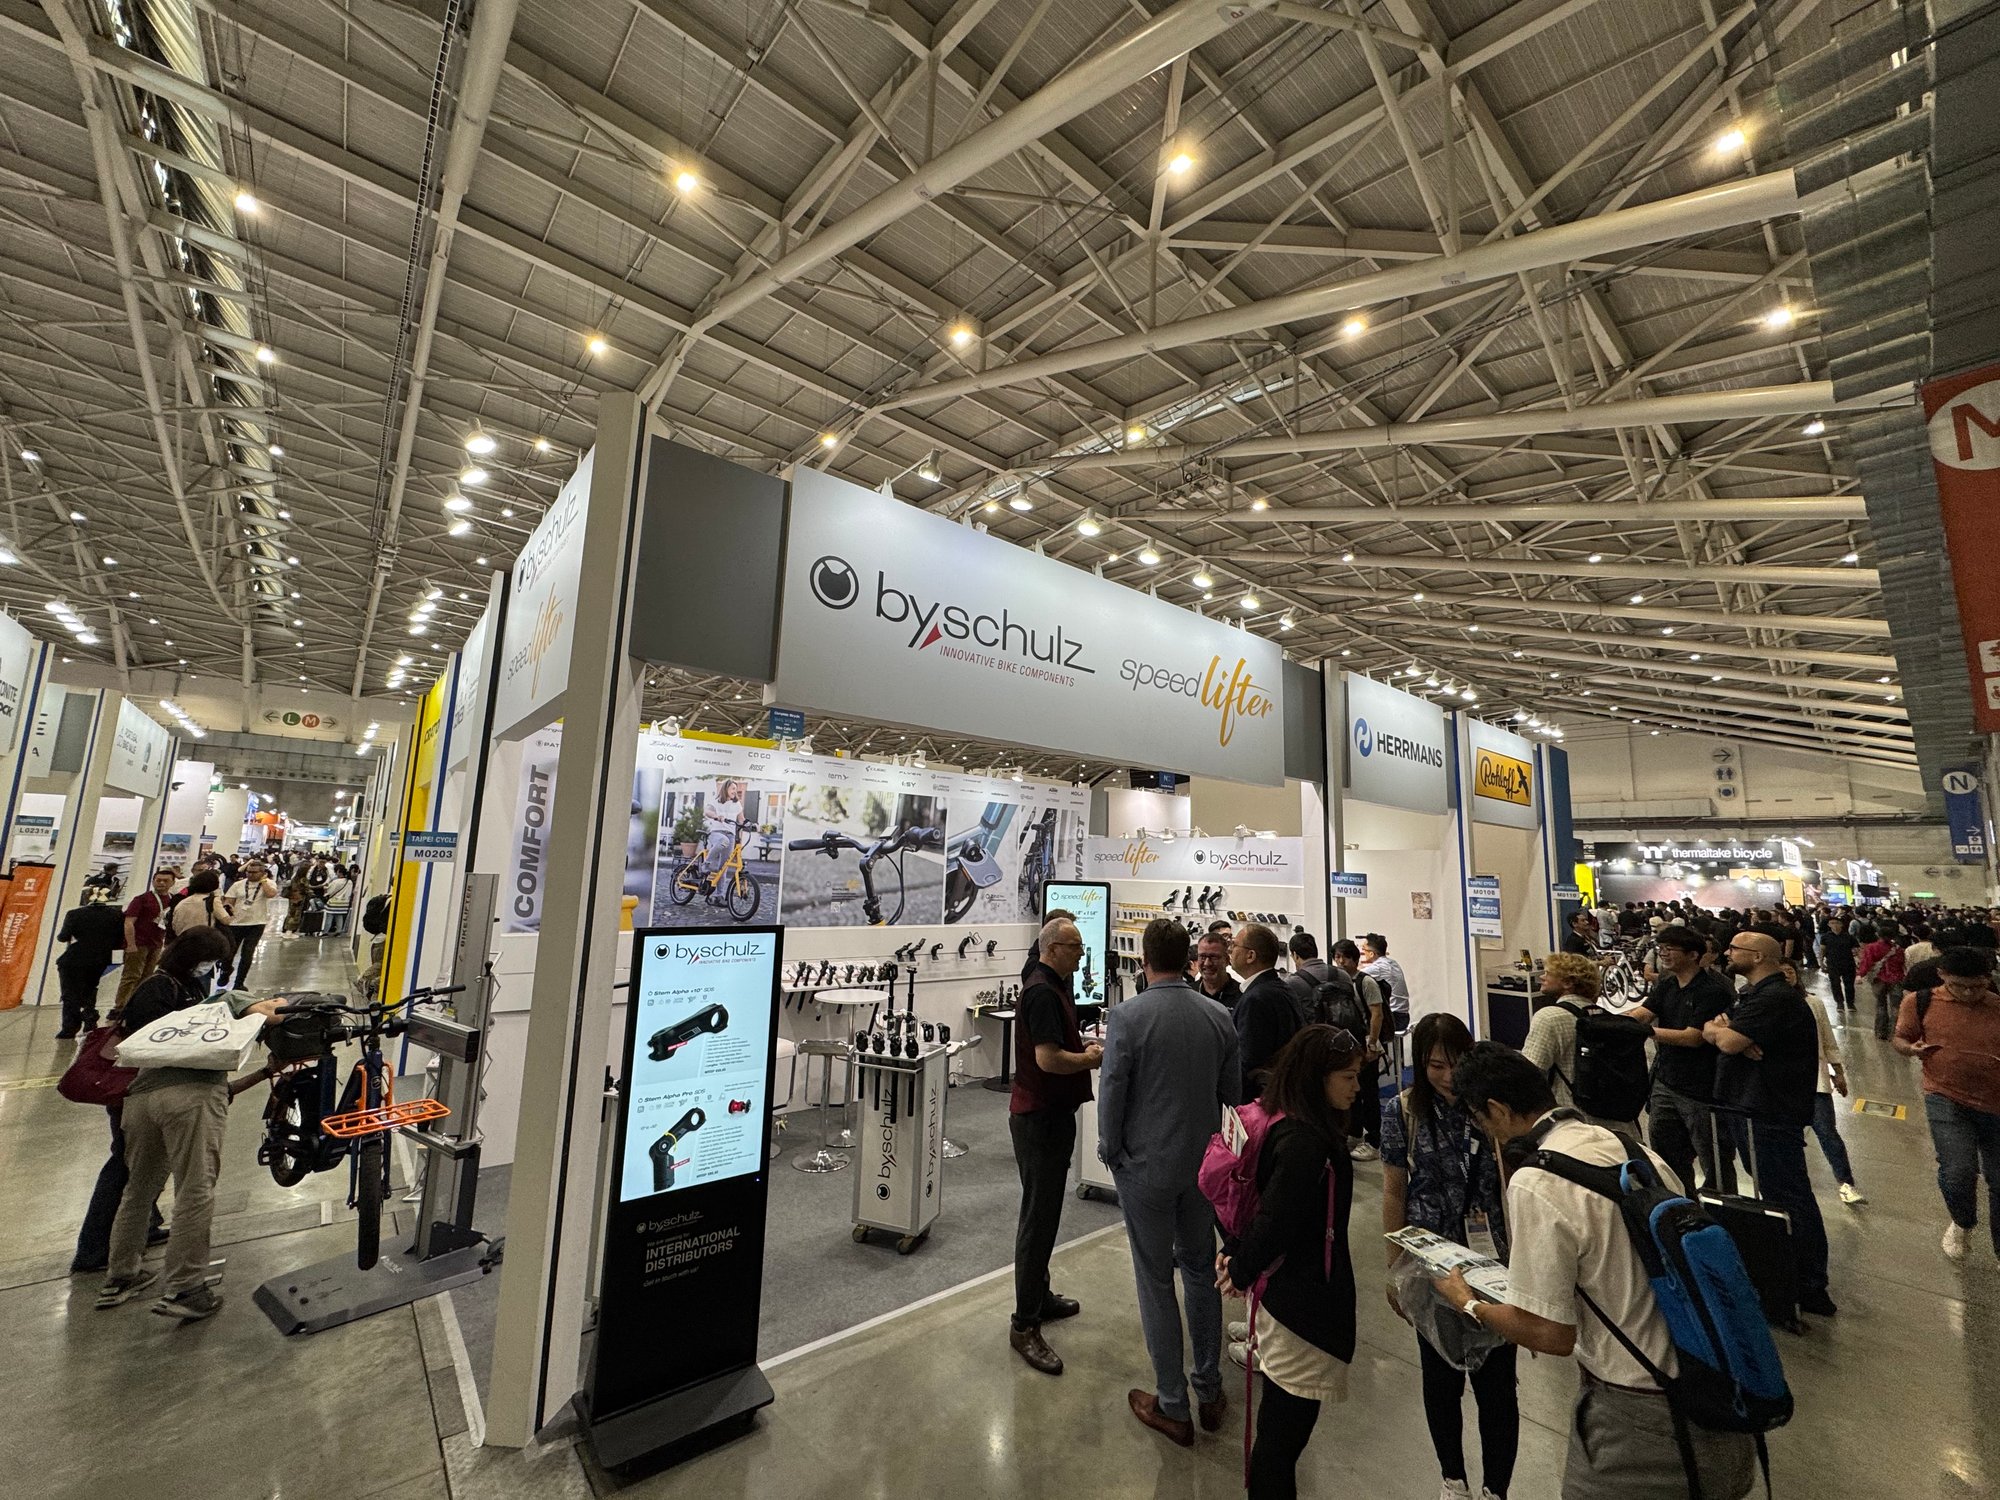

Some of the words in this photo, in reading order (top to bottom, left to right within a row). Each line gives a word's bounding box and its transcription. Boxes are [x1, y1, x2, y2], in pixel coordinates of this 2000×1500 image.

[940, 644, 996, 669] INNOVATIVE
[996, 658, 1018, 675] BIKE
[1018, 663, 1075, 688] COMPONENTS
[288, 713, 294, 724] L
[306, 716, 316, 726] M
[1377, 731, 1443, 768] HERRMANS
[1480, 756, 1520, 800] Rohloff
[1950, 775, 1968, 790] N
[414, 850, 452, 858] M0203
[514, 764, 549, 918] COMFORT
[1672, 849, 1732, 858] thermaltake
[1734, 849, 1773, 859] bicycle
[645, 1240, 733, 1273] DISTRIBUTORS
[646, 1226, 741, 1260] INTERNATIONAL
